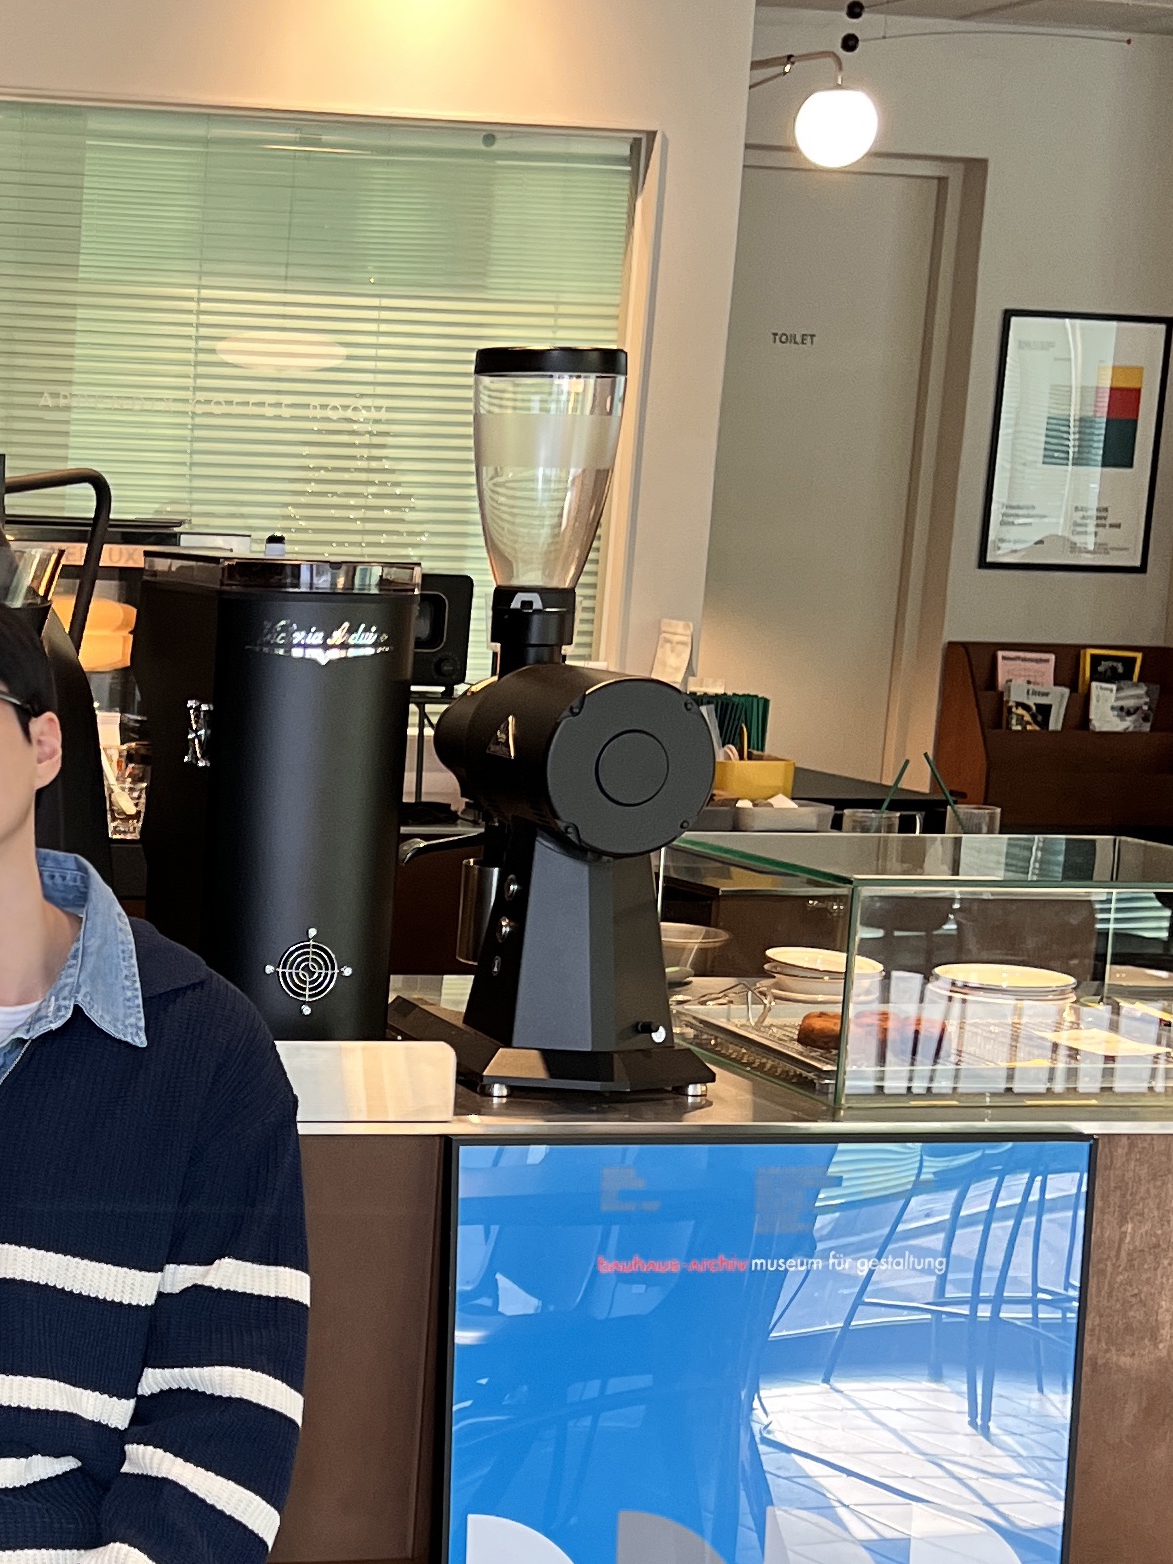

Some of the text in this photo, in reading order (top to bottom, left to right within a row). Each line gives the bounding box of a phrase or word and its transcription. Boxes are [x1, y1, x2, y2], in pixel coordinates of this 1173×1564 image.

[771, 332, 817, 346] TOILET
[192, 399, 292, 418] COFFEE
[309, 404, 387, 421] ROOM
[751, 1257, 823, 1271] museum
[828, 1250, 852, 1271] für
[856, 1250, 947, 1277] gestaltung
